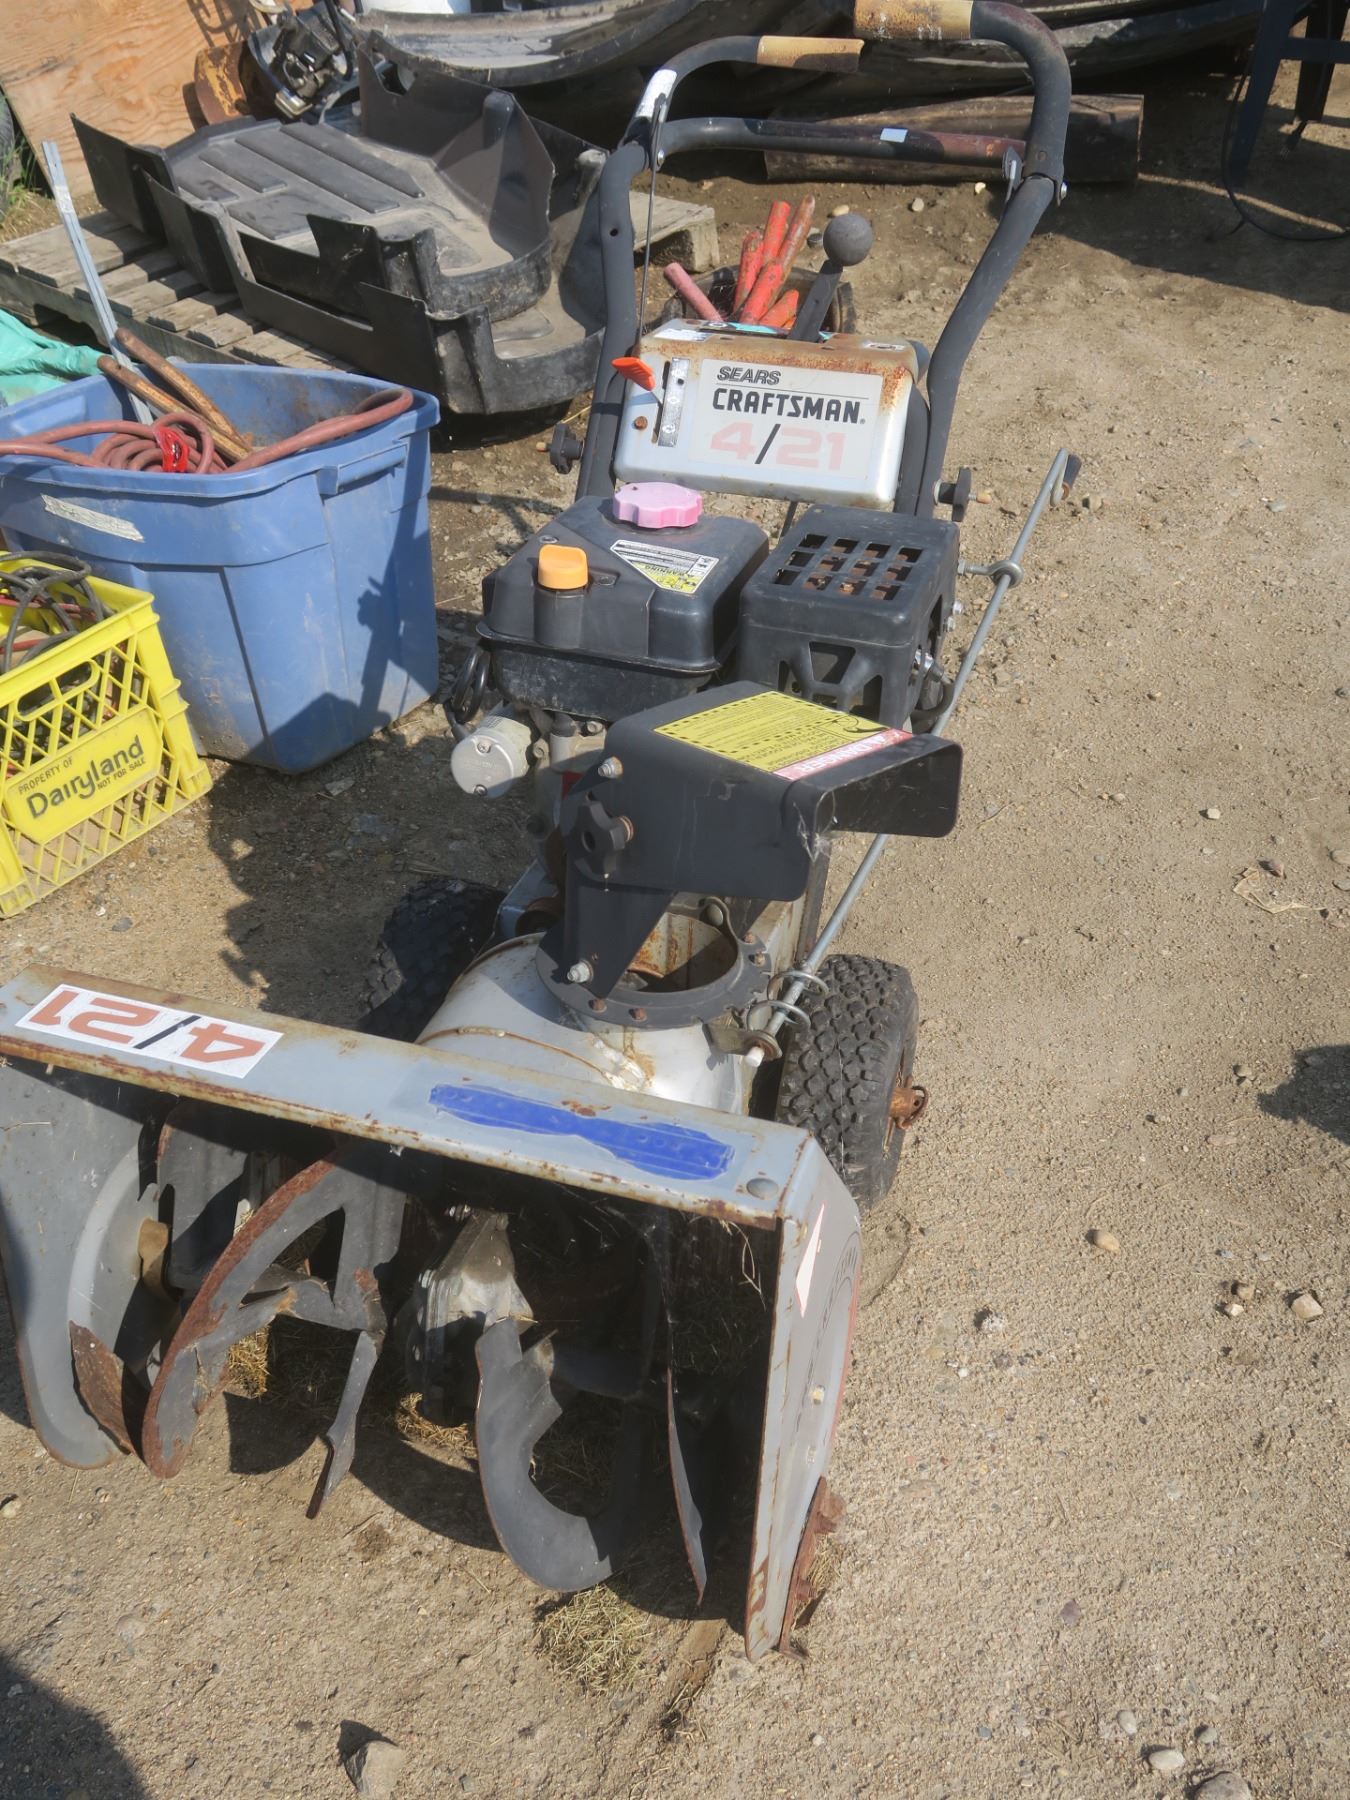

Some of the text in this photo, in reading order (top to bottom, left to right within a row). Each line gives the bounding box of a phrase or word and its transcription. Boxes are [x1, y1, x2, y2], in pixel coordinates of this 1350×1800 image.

[717, 366, 781, 385] SEARS
[710, 421, 847, 471] 4/21
[645, 564, 685, 577] WARNING
[97, 758, 146, 790] NOT FOR SALE
[796, 741, 873, 772] DANGER
[18, 756, 74, 795] PROPERTY OF
[27, 734, 145, 819] Dairyland
[29, 991, 266, 1063] 4/21
